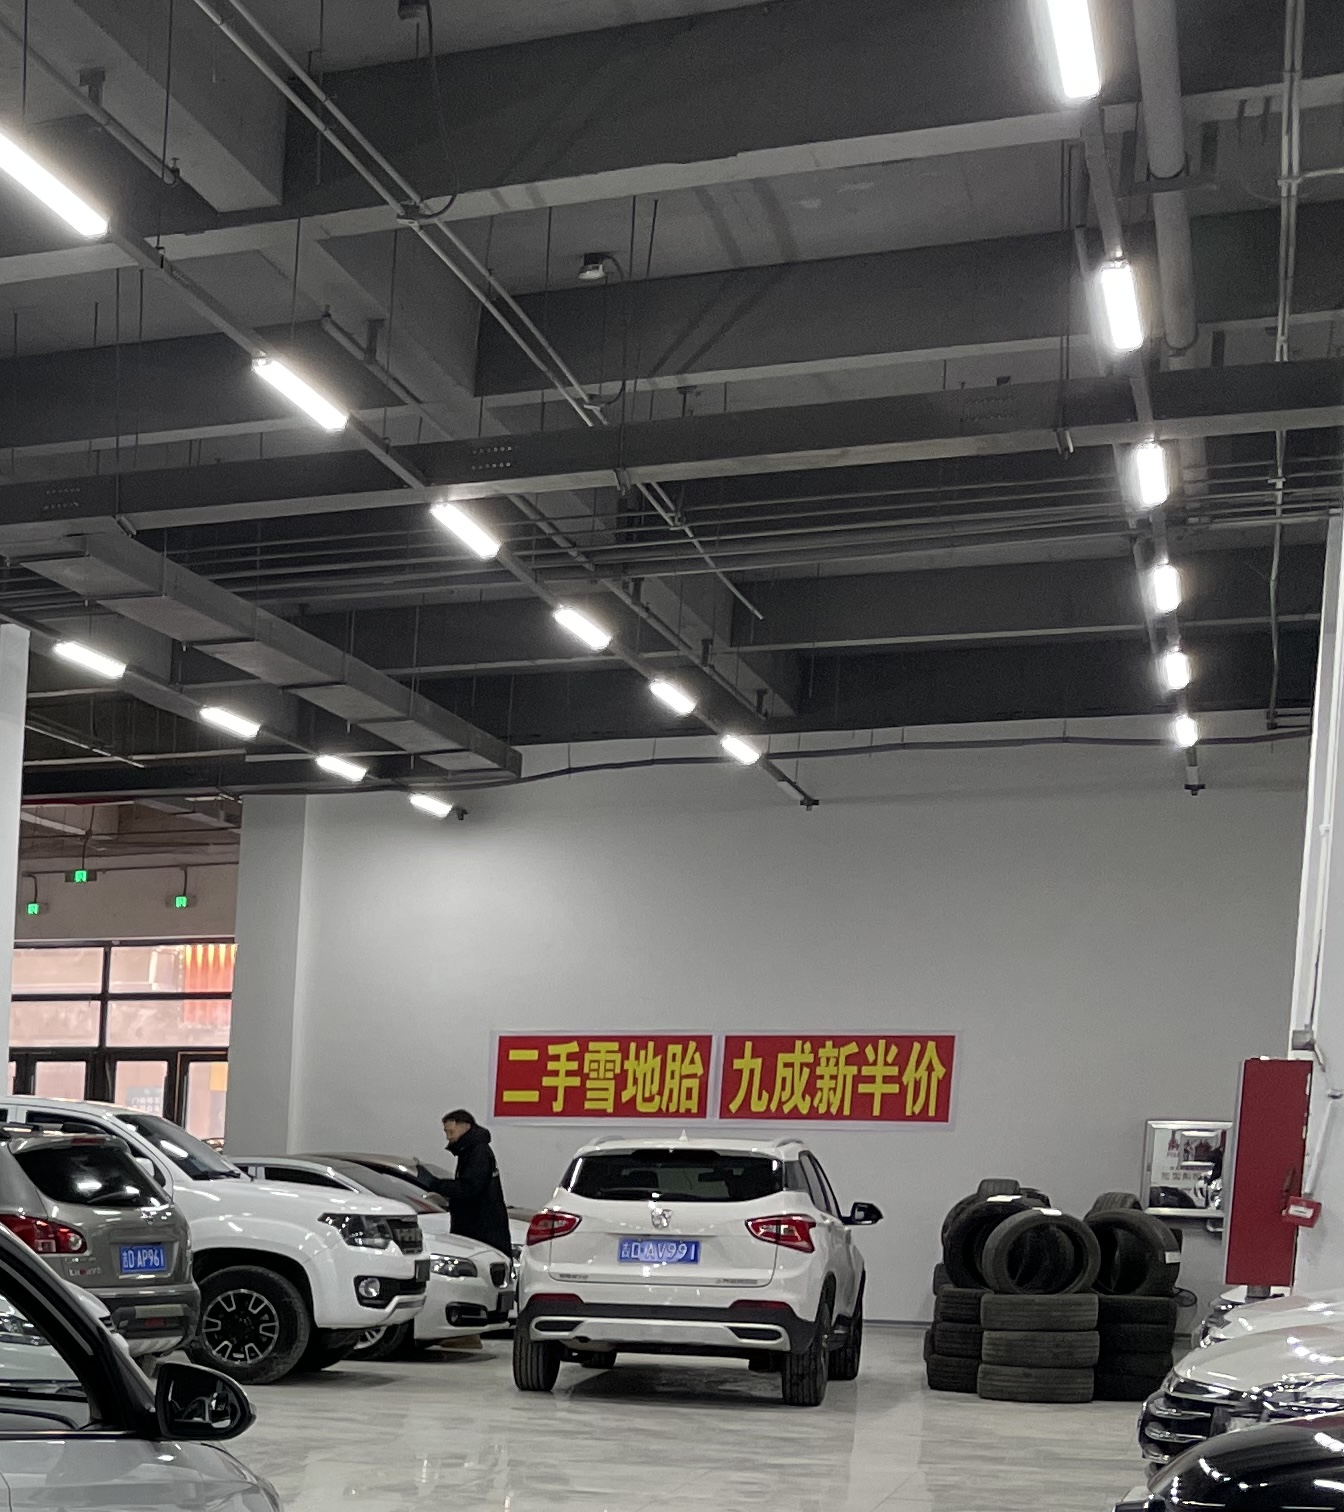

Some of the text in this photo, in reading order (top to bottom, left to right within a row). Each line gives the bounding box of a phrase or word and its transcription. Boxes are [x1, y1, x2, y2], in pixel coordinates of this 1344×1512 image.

[503, 1041, 704, 1113] 二手雪地胎
[728, 1040, 947, 1116] 九成新半价
